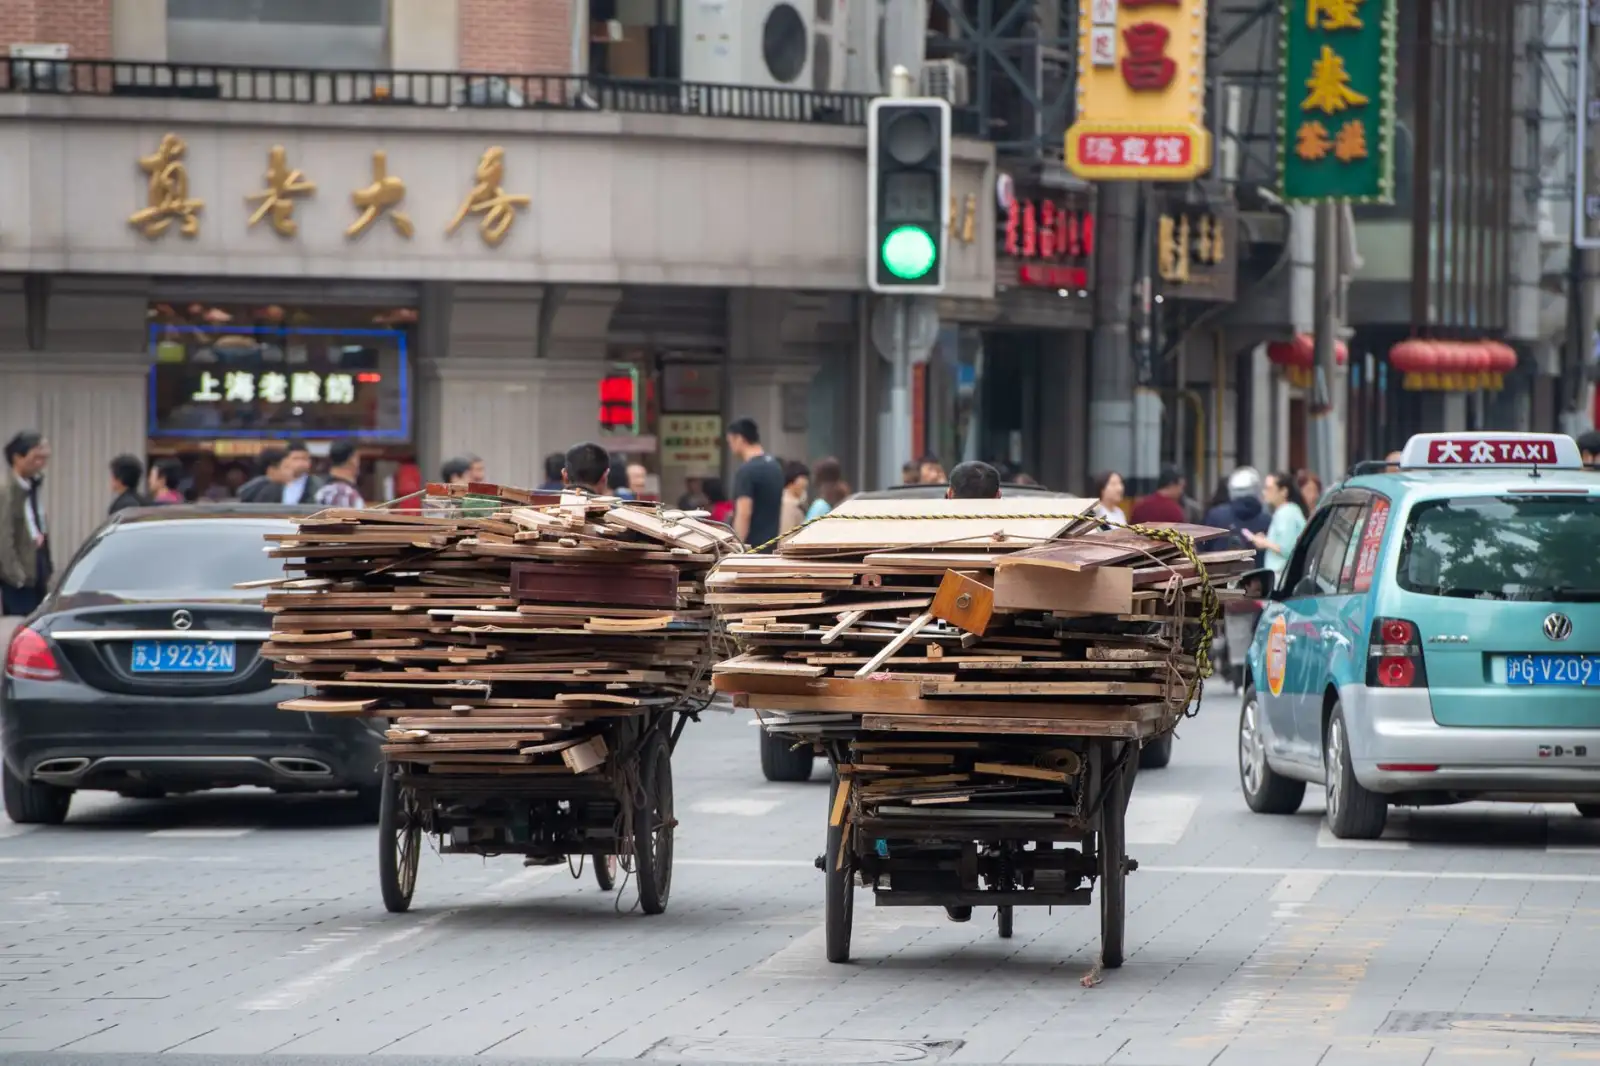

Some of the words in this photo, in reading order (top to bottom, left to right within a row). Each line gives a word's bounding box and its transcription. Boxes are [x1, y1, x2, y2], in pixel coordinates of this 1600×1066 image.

[192, 371, 355, 403] 上海老酸奶
[1437, 440, 1495, 463] 大众
[1499, 443, 1548, 460] TAXI
